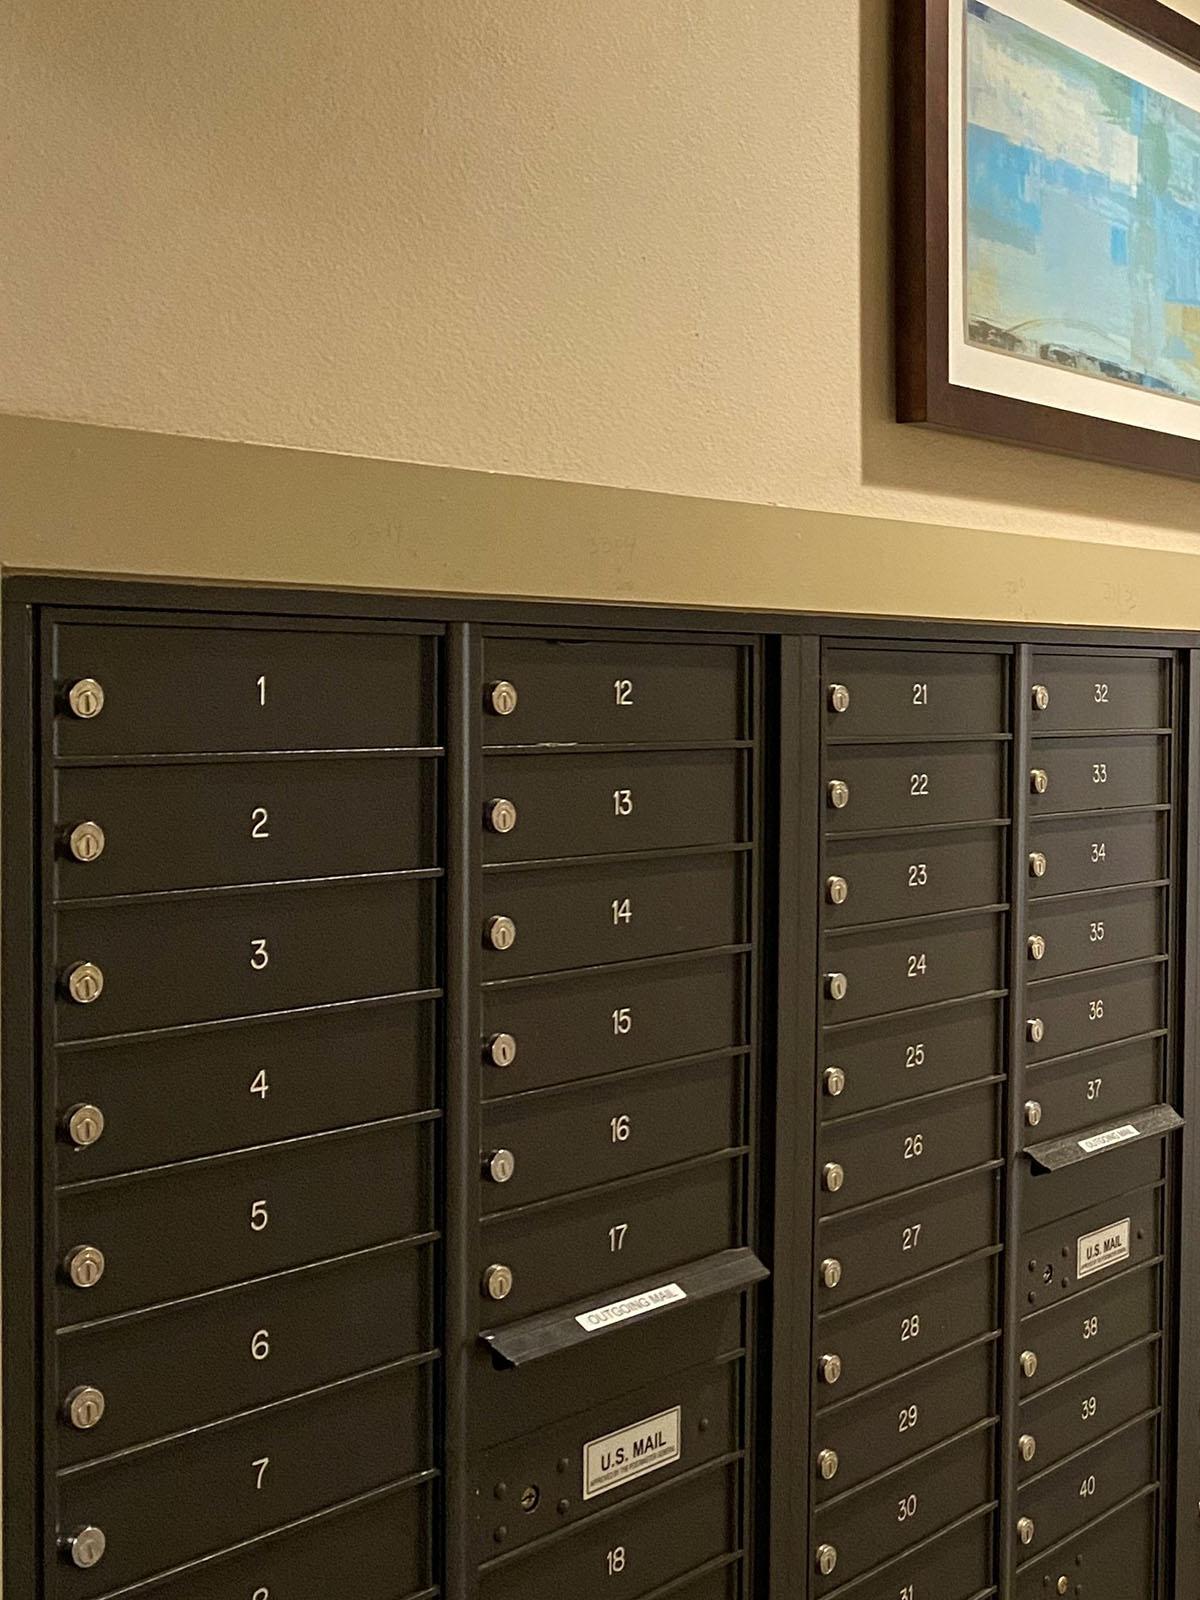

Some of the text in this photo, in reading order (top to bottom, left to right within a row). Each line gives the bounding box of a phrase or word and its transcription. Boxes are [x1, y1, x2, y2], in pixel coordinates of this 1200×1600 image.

[256, 675, 266, 706] 1
[614, 679, 634, 705] 12
[912, 683, 927, 705] 21
[1094, 683, 1109, 703] 32
[910, 773, 929, 796] 22
[1092, 763, 1108, 784] 33
[613, 789, 633, 816] 13
[251, 807, 270, 838] 2
[1091, 843, 1106, 863] 34
[908, 864, 928, 887] 23
[611, 898, 633, 925] 14
[1089, 921, 1105, 942] 35
[250, 939, 269, 970] 3
[907, 953, 927, 977] 24
[611, 1007, 632, 1035] 15
[1088, 999, 1104, 1021] 36
[905, 1043, 925, 1068] 25
[249, 1069, 269, 1099] 4
[1086, 1078, 1102, 1100] 37
[610, 1115, 630, 1143] 16
[904, 1134, 923, 1159] 26
[250, 1200, 268, 1231] 5
[608, 1223, 628, 1252] 17
[902, 1223, 921, 1251] 27
[1086, 1243, 1102, 1260] U.S.
[1103, 1235, 1122, 1253] MAIL
[587, 1288, 679, 1325] OUTGOING MAIL
[901, 1314, 920, 1342] 28
[1082, 1316, 1098, 1339] 38
[251, 1329, 269, 1360] 6
[898, 1404, 918, 1433] 29
[1081, 1396, 1097, 1420] 39
[601, 1447, 629, 1471] U.S.
[633, 1431, 667, 1458] MAIL
[251, 1457, 270, 1489] 7
[1079, 1475, 1096, 1497] 40
[897, 1494, 917, 1522] 30
[606, 1546, 626, 1576] 18
